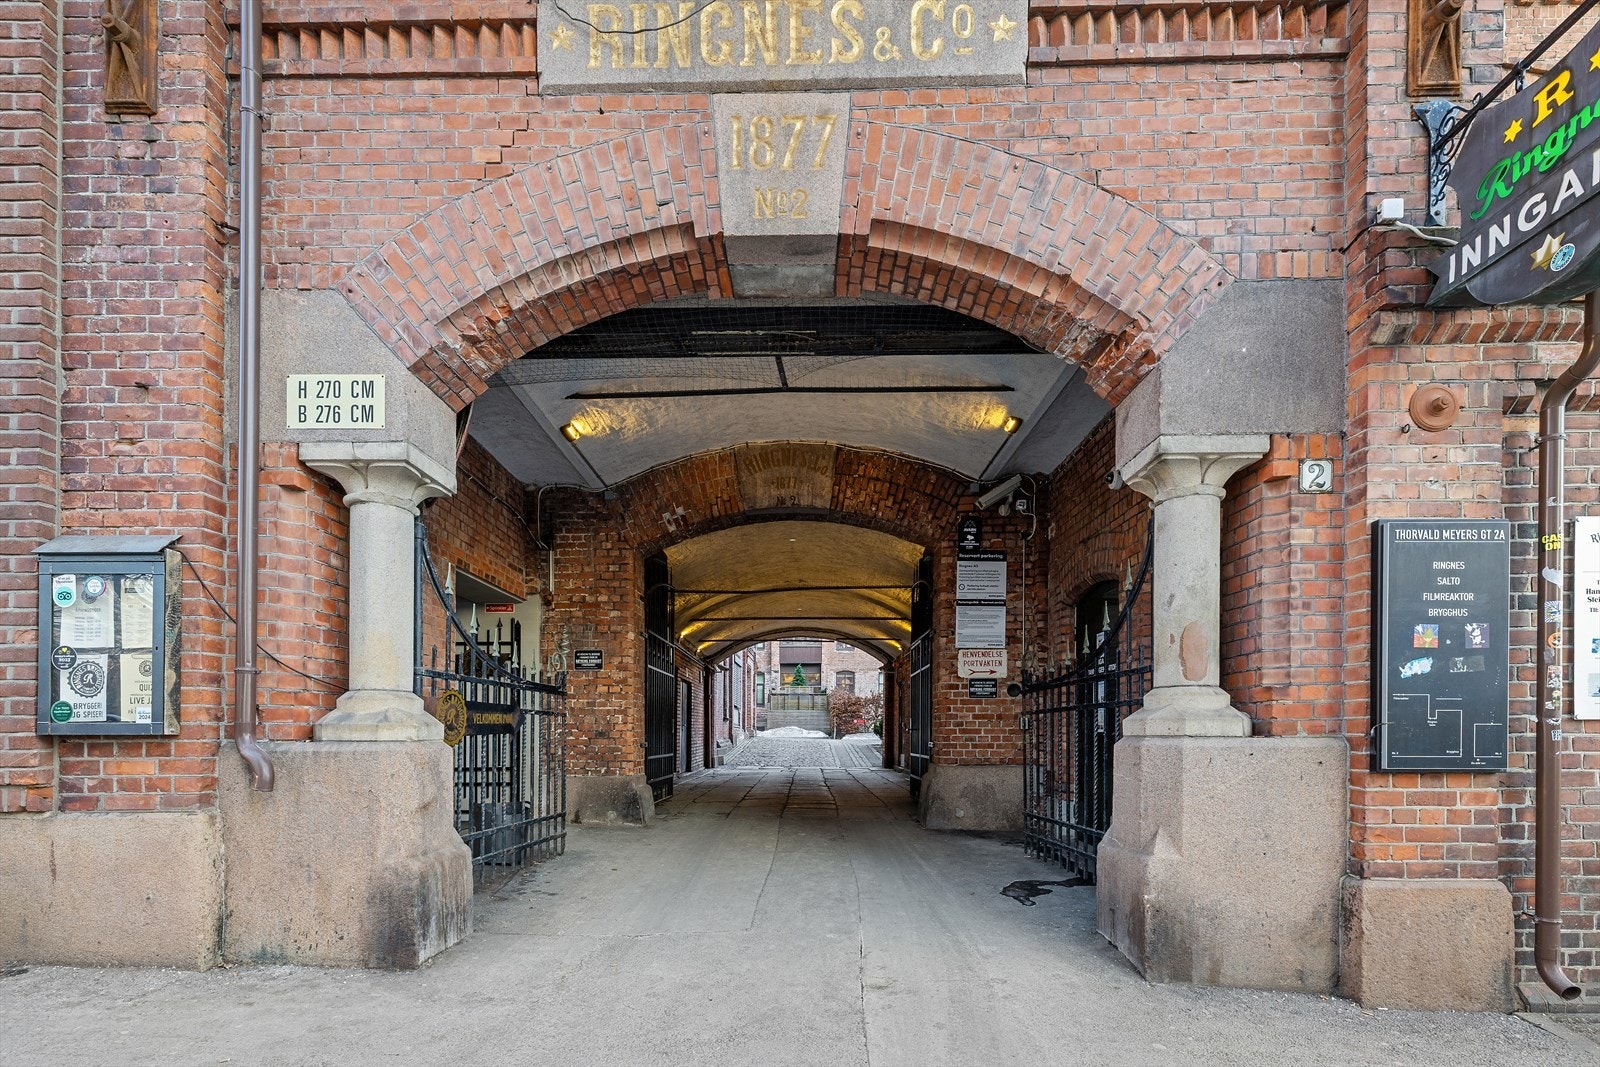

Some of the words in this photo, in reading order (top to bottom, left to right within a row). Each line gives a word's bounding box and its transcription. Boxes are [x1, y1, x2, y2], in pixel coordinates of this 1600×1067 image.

[586, 0, 865, 68] RINGNES
[874, 26, 901, 62] &
[1532, 70, 1574, 128] R
[731, 114, 838, 169] 1877
[298, 381, 307, 399] H
[316, 380, 340, 399] 270
[351, 380, 374, 399] CM
[298, 404, 307, 423] B
[315, 404, 340, 423] 276
[350, 404, 374, 423] CM
[1308, 464, 1325, 488] 2
[1395, 529, 1439, 540] THORVALD
[1443, 529, 1477, 540] MEYERS
[1481, 529, 1491, 540] GT
[1494, 529, 1505, 540] 2A
[1433, 561, 1465, 570] RINGNES
[1437, 576, 1460, 585] SALTO
[1423, 592, 1474, 601] FILMREAKTOR
[1428, 608, 1468, 617] BRYGGHUS
[129, 696, 145, 705] LIVE
[146, 696, 152, 705] J
